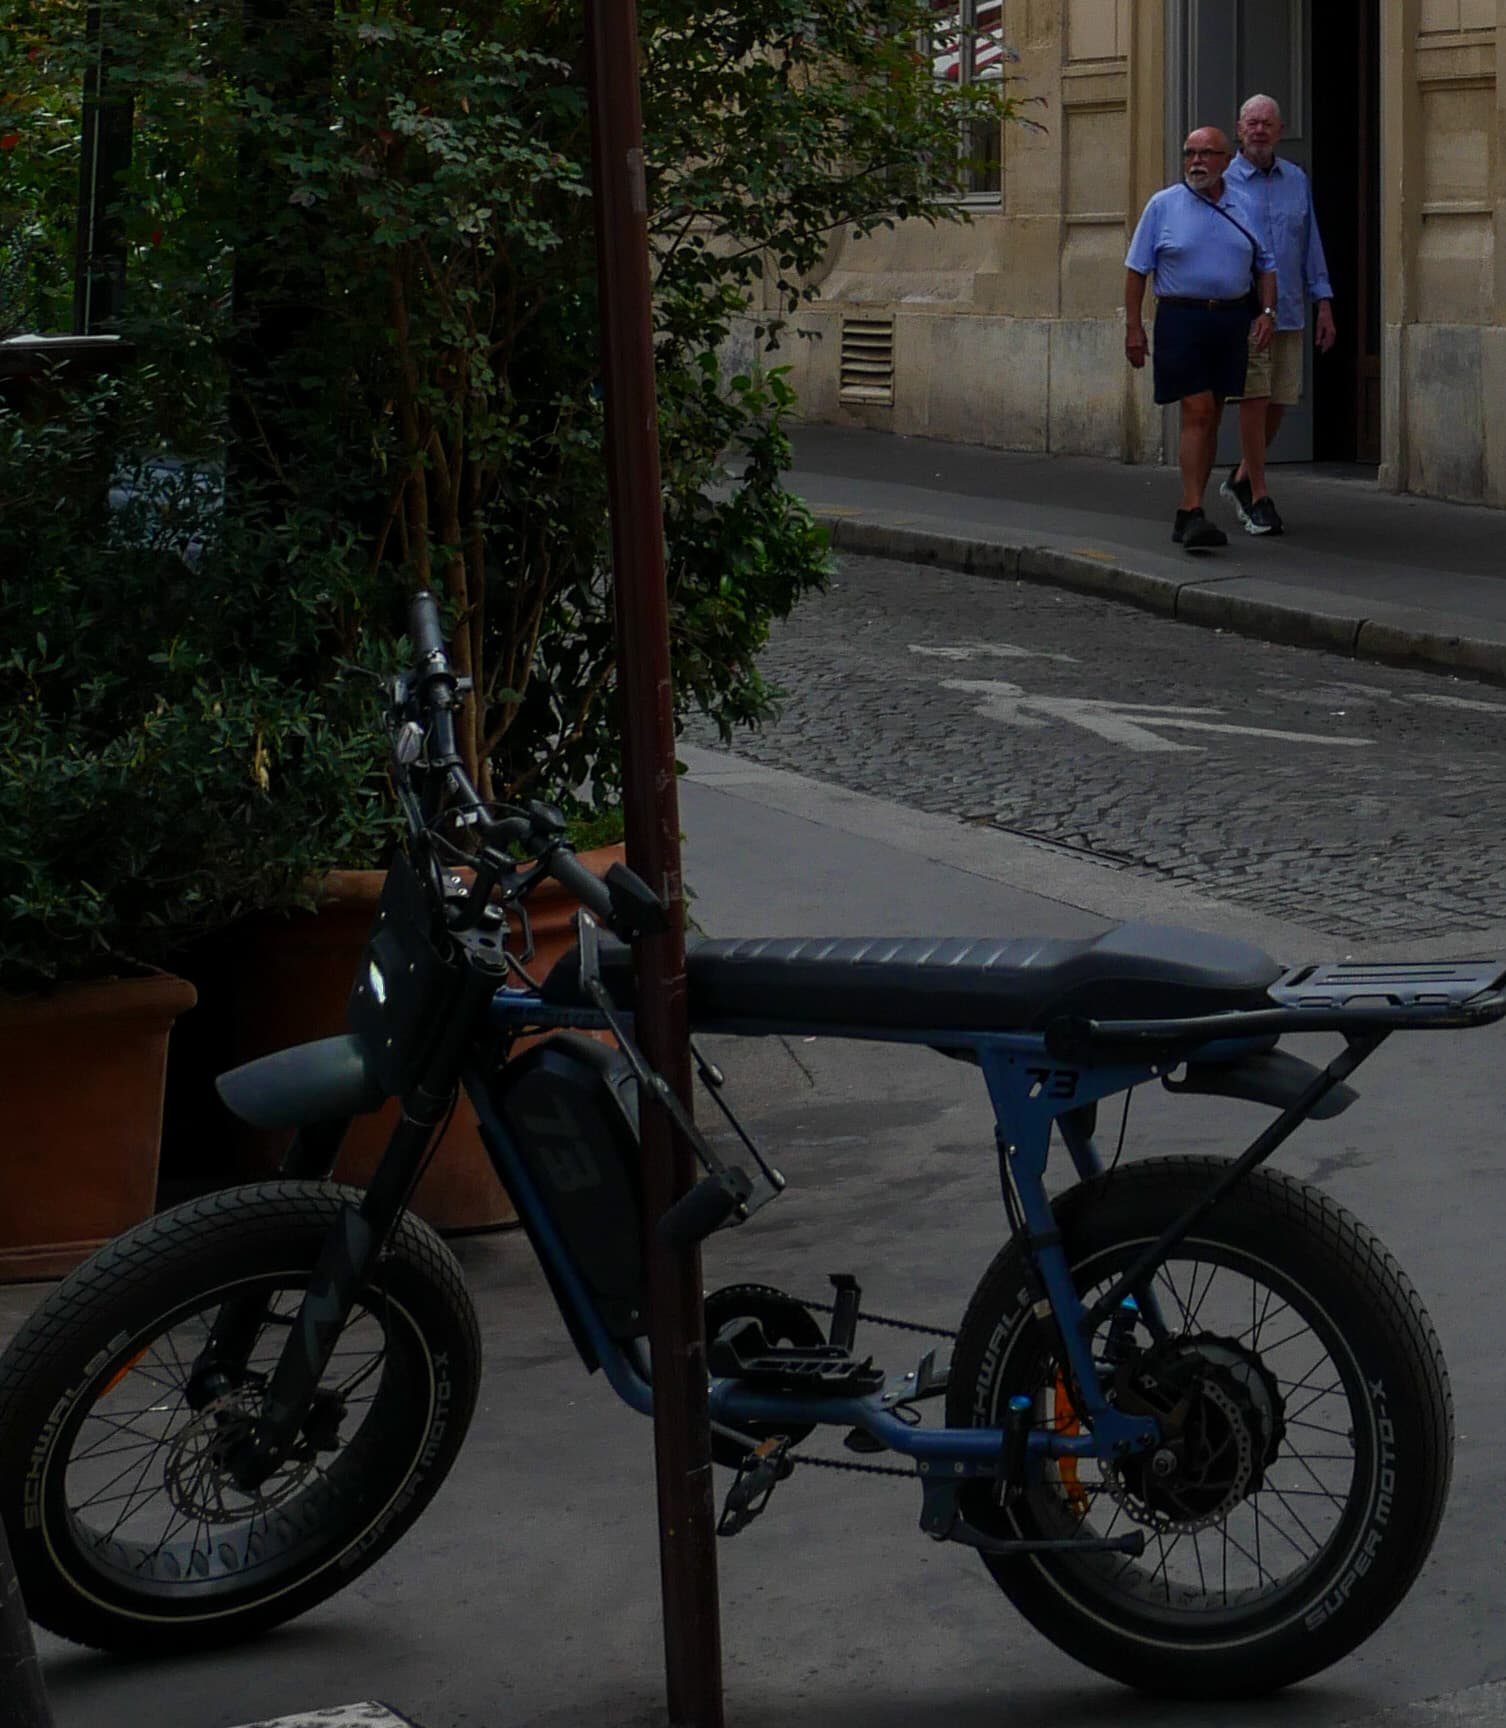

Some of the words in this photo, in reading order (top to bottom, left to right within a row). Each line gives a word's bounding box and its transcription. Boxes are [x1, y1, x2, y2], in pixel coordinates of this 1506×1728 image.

[1026, 1068, 1078, 1099] 73
[24, 1329, 130, 1529] SCHWALBE
[339, 1471, 424, 1568] SUPER
[420, 1351, 451, 1468] MOTO-X
[1305, 1533, 1384, 1632] SUPER
[1371, 1378, 1397, 1527] MOTO-X
